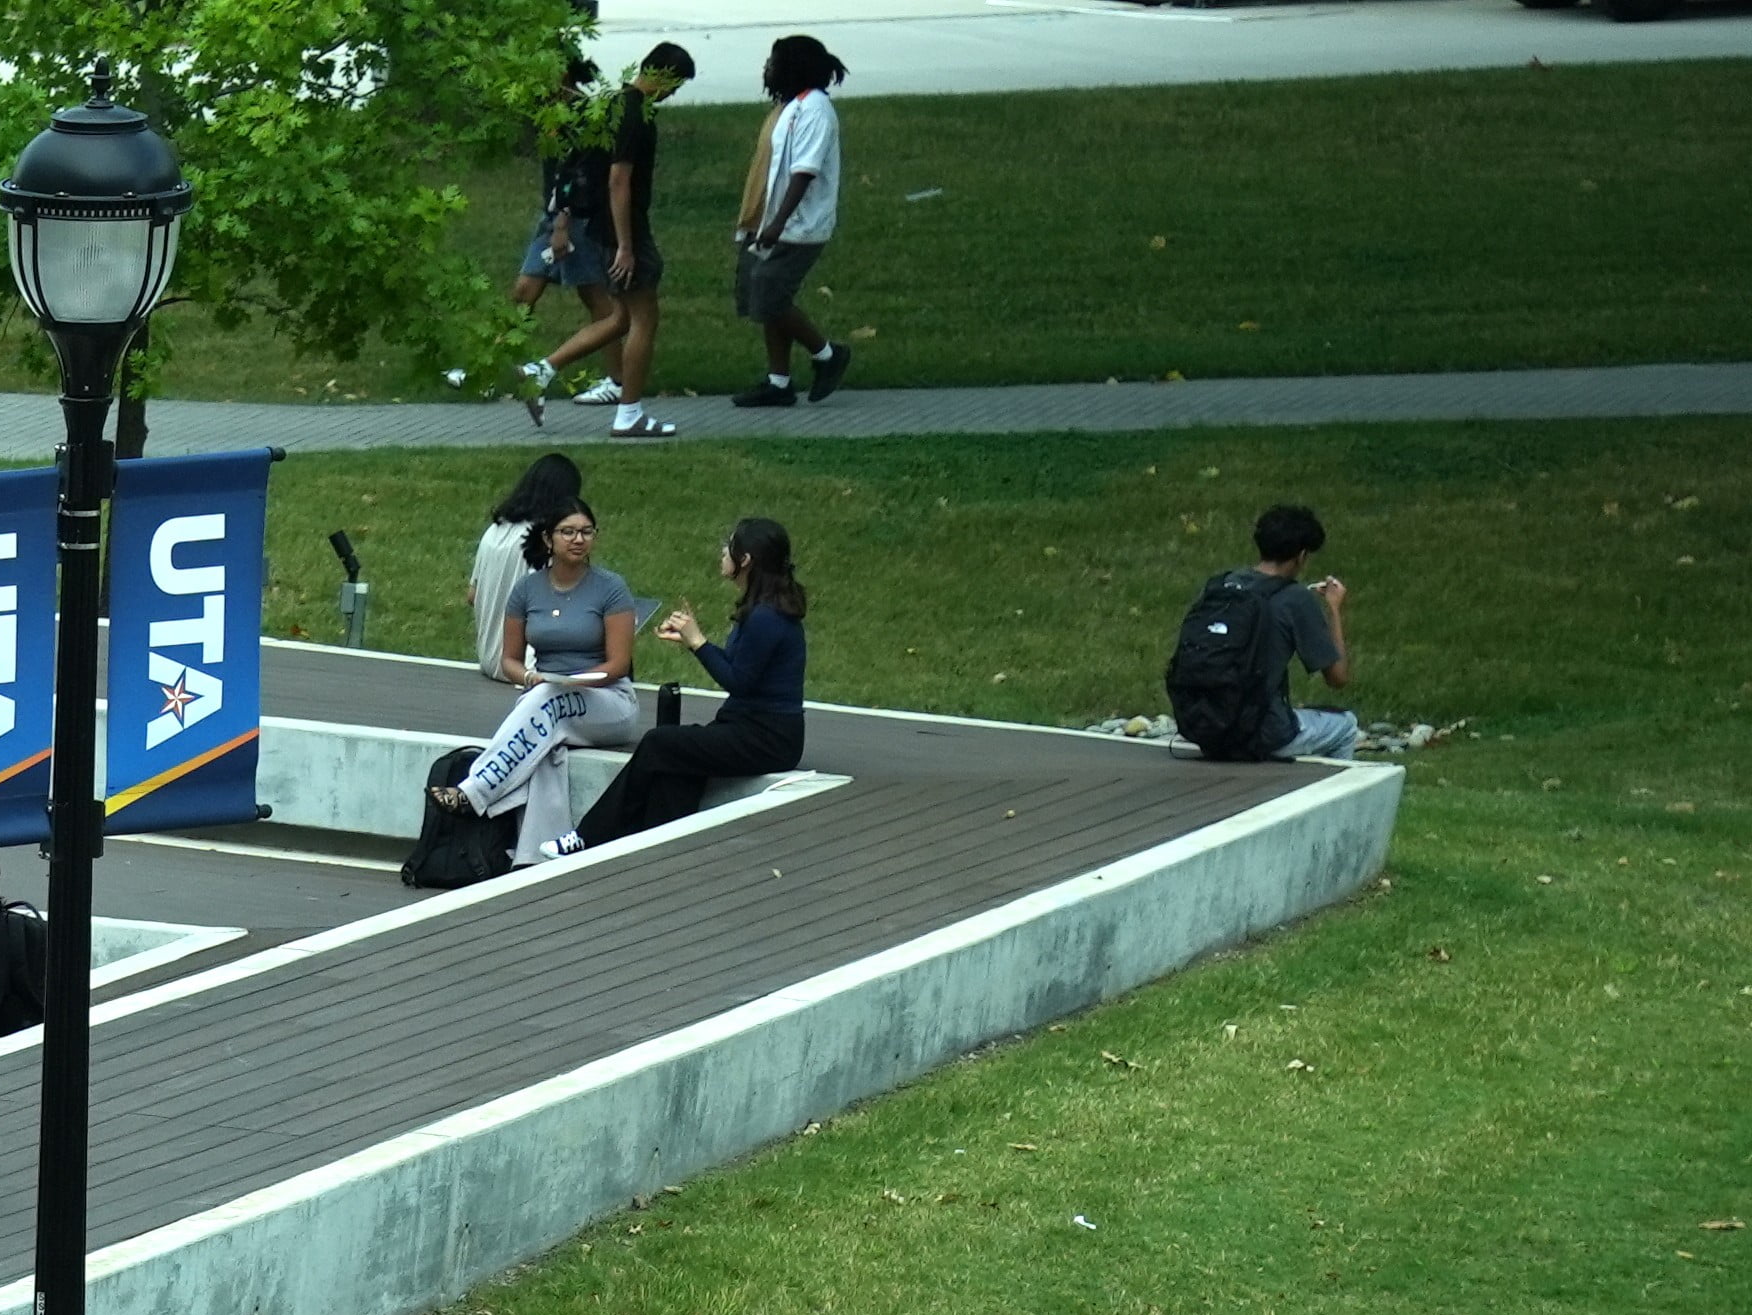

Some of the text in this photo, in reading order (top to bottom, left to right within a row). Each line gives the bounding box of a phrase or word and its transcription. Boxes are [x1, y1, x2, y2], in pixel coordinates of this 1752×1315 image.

[146, 513, 225, 750] UTA
[476, 692, 587, 790] TRACK & FIELD
